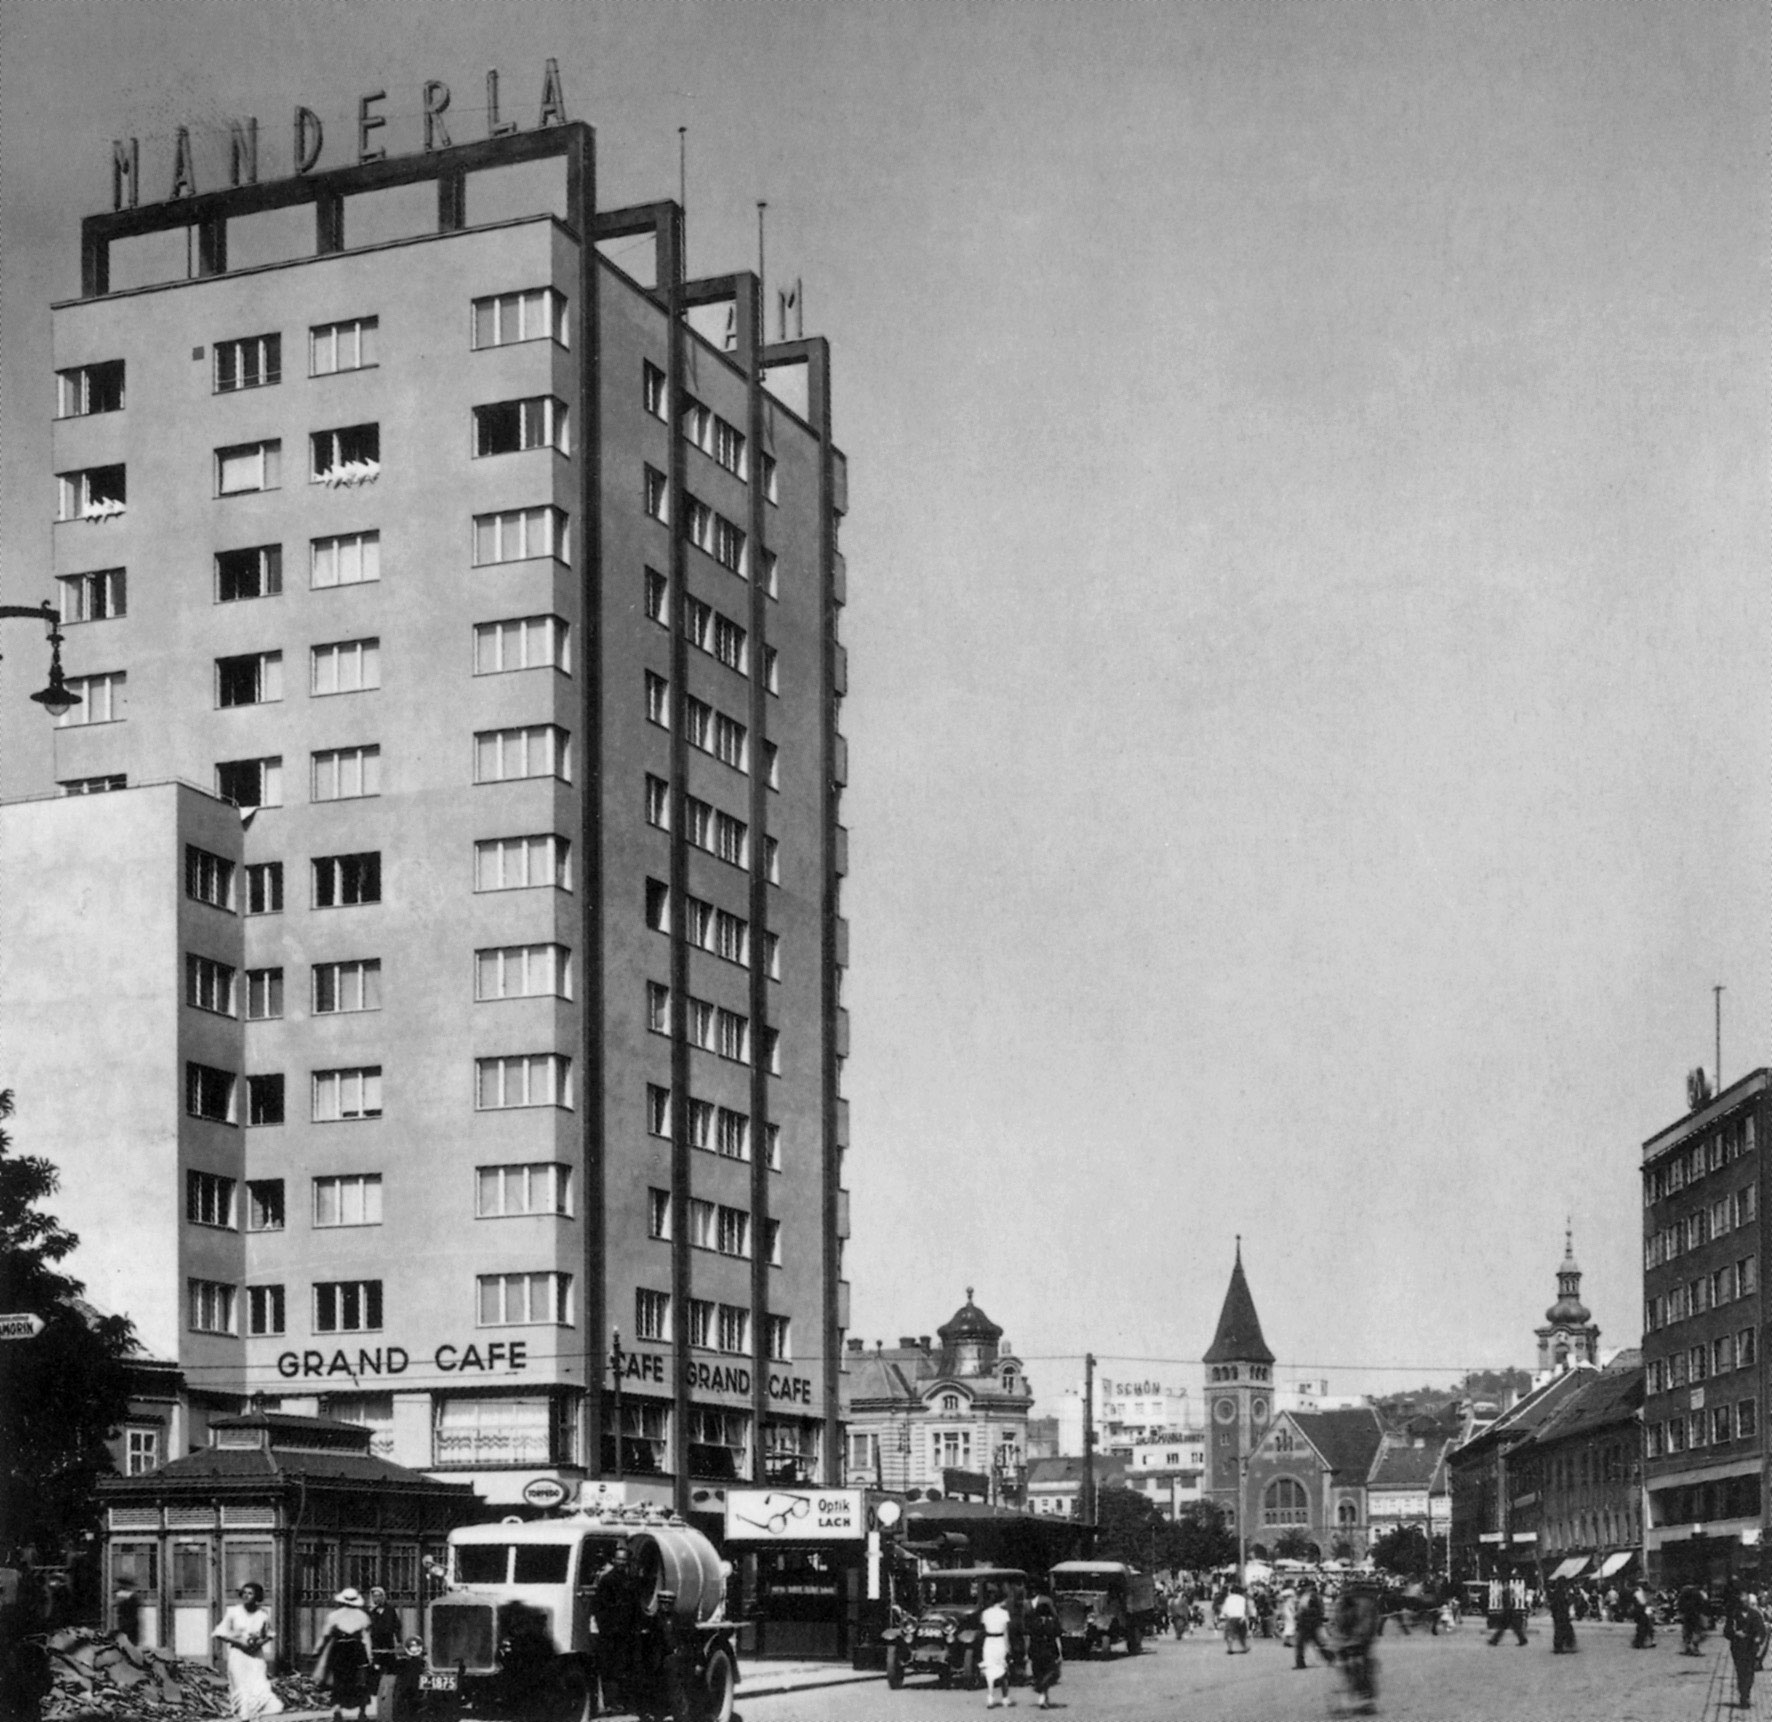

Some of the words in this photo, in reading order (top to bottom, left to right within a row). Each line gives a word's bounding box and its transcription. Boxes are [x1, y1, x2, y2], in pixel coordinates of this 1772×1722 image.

[112, 57, 566, 212] MANDERLA
[277, 1346, 410, 1378] GRAND
[434, 1341, 527, 1372] CAFE
[685, 1361, 751, 1395] GRAND
[768, 1374, 811, 1404] CAFE
[527, 1489, 560, 1498] TORPEDO
[818, 1499, 851, 1514] Optik
[818, 1517, 851, 1528] LACH
[420, 1676, 456, 1690] P-1875
